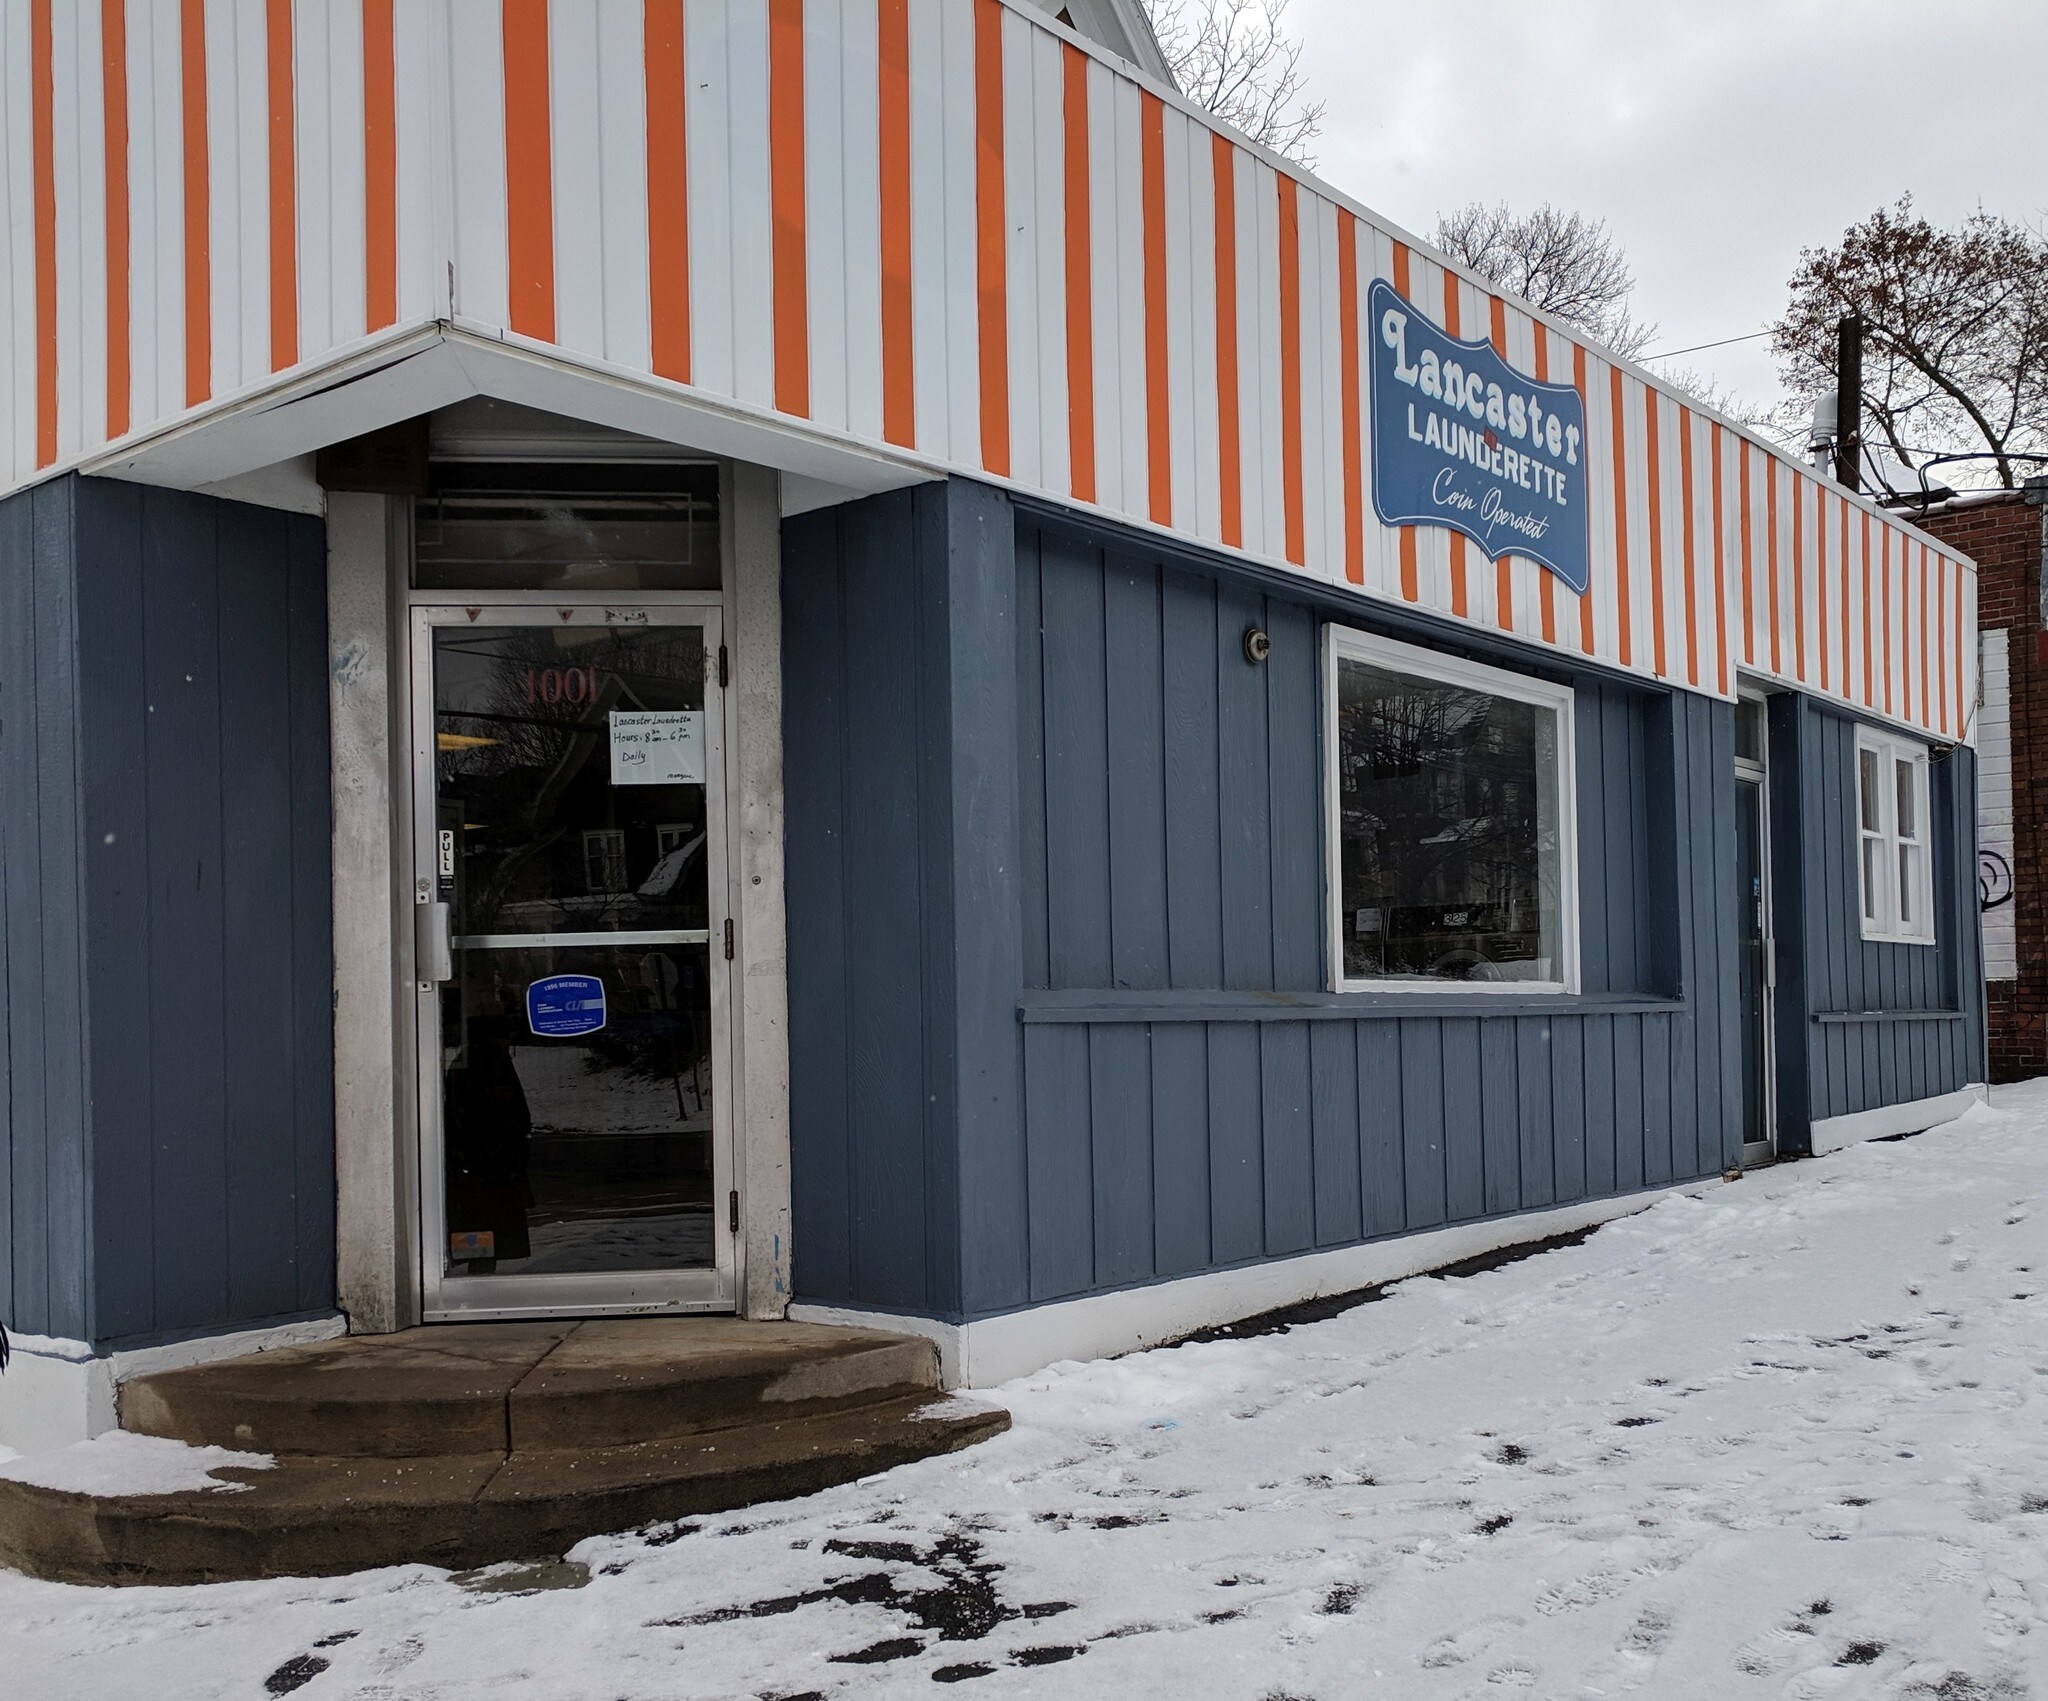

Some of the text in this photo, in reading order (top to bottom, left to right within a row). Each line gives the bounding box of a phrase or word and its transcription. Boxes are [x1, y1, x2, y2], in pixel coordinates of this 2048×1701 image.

[1382, 308, 1580, 466] Lancaster
[1408, 402, 1567, 507] LAUNDERETTE
[1432, 467, 1550, 540] Coin Operated
[527, 666, 597, 704] 1001
[622, 750, 646, 765] Daily
[442, 832, 451, 871] PULL
[558, 981, 588, 989] MEMBER
